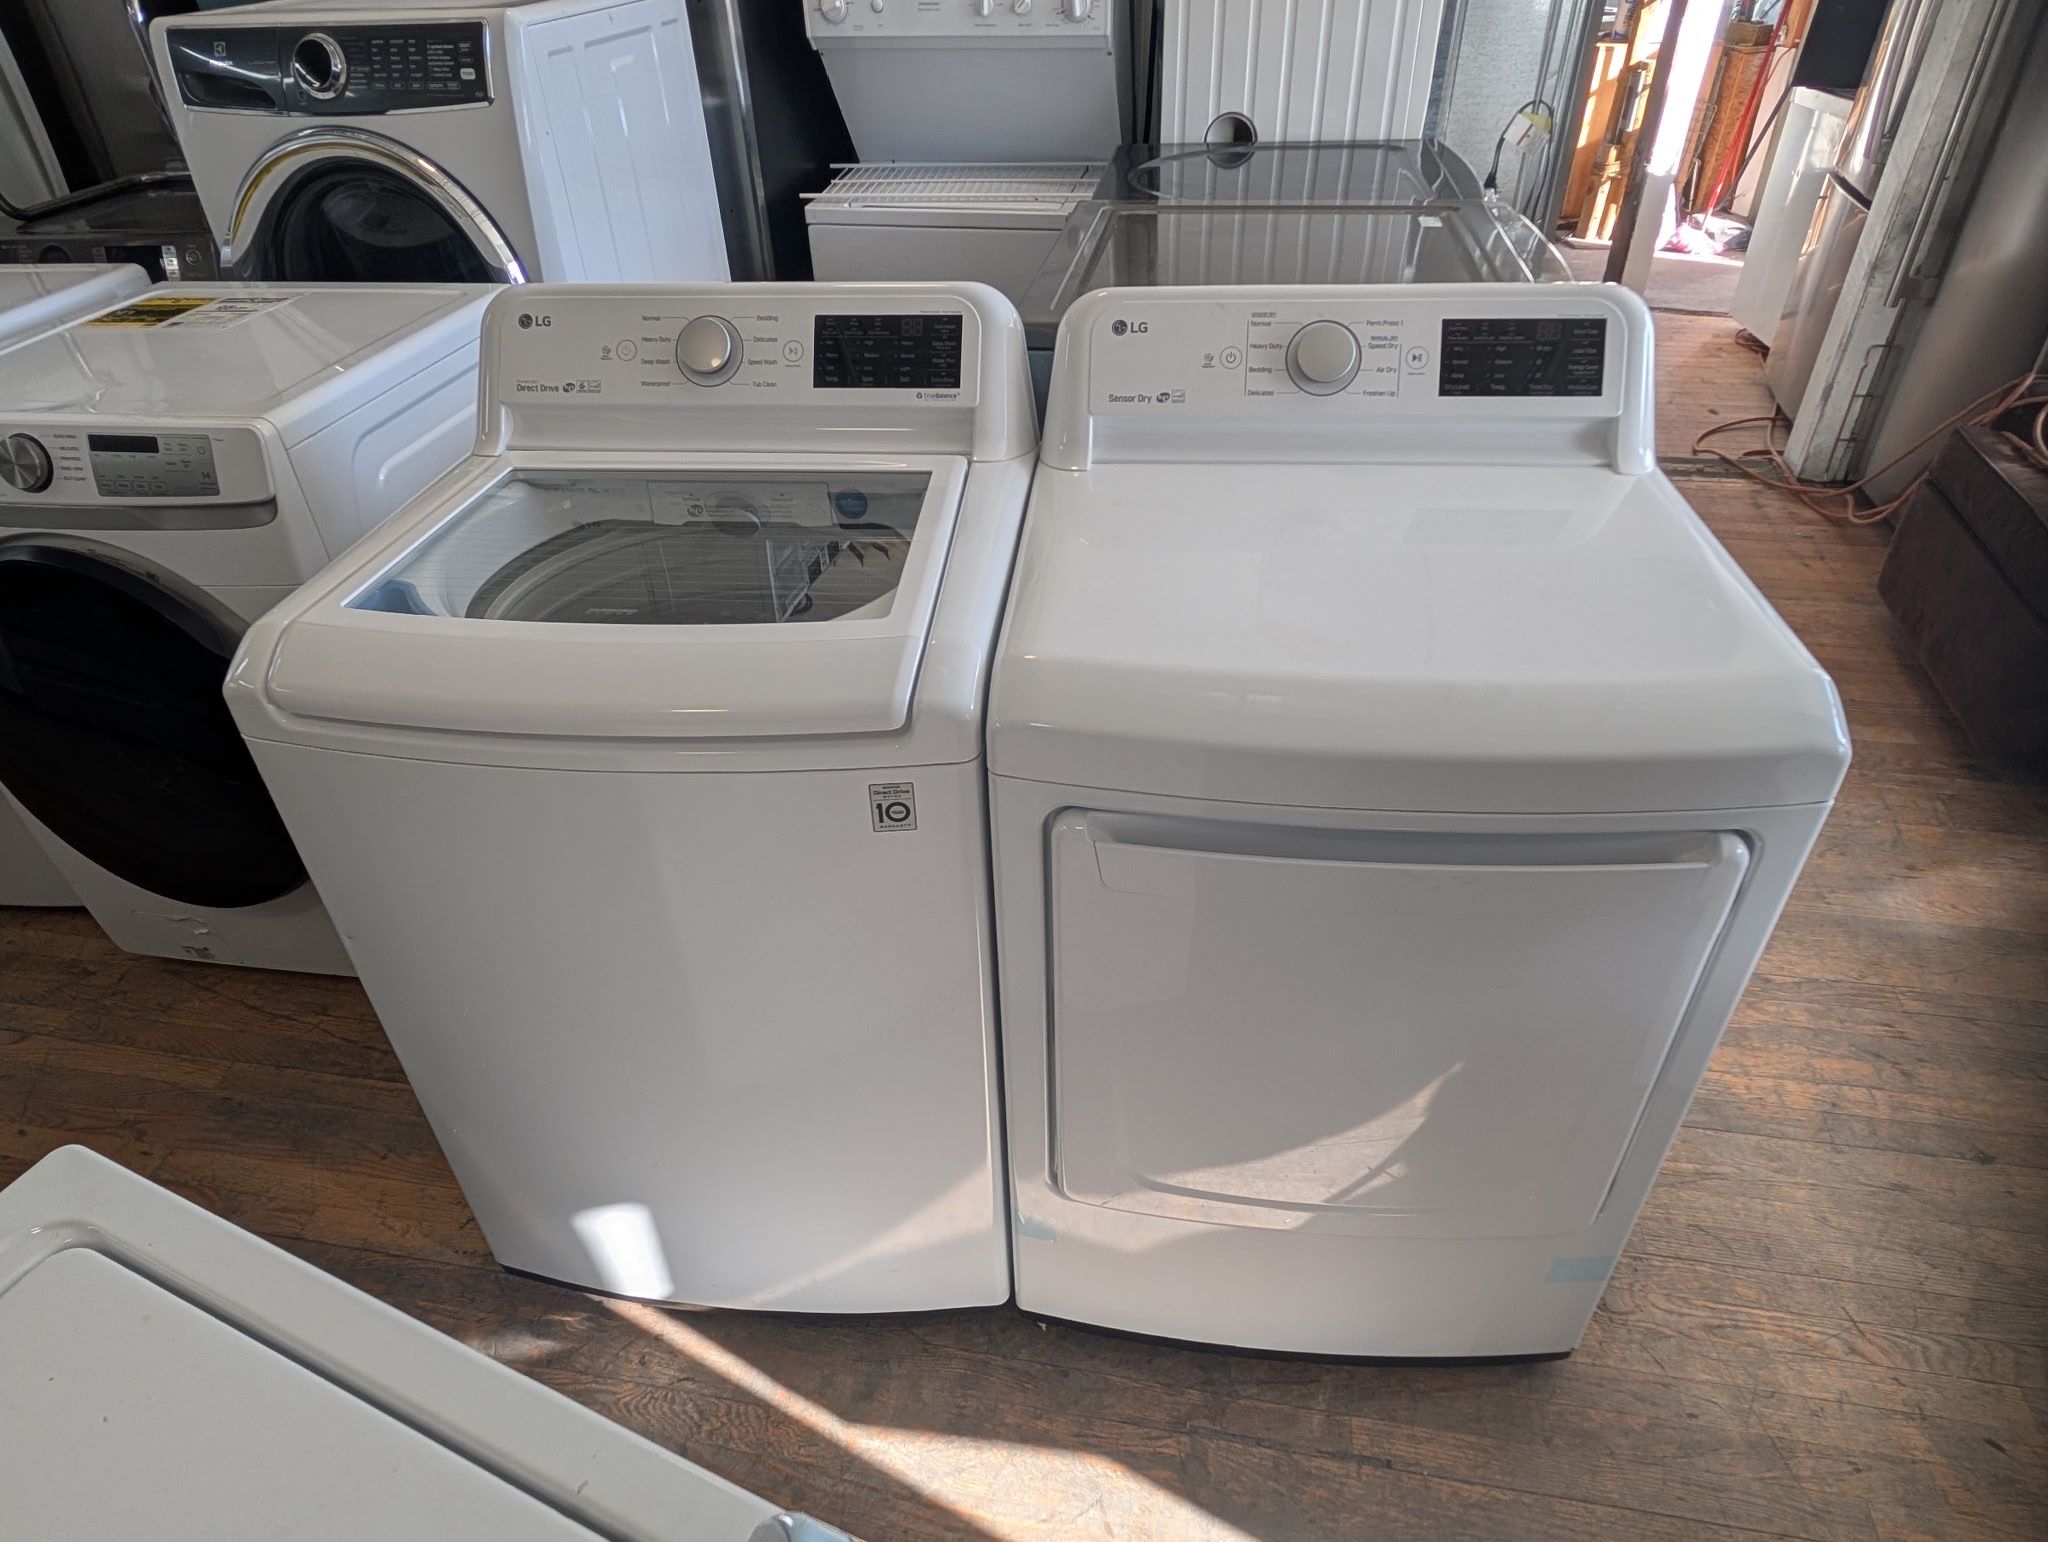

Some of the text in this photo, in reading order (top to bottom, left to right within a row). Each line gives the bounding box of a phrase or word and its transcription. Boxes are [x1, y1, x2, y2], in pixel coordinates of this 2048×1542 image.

[535, 315, 552, 327] LG
[1130, 321, 1148, 333] LG
[516, 383, 539, 392] Direct
[540, 384, 560, 392] Drive
[1108, 394, 1152, 404] Sensor Dry
[876, 802, 910, 823] 10
